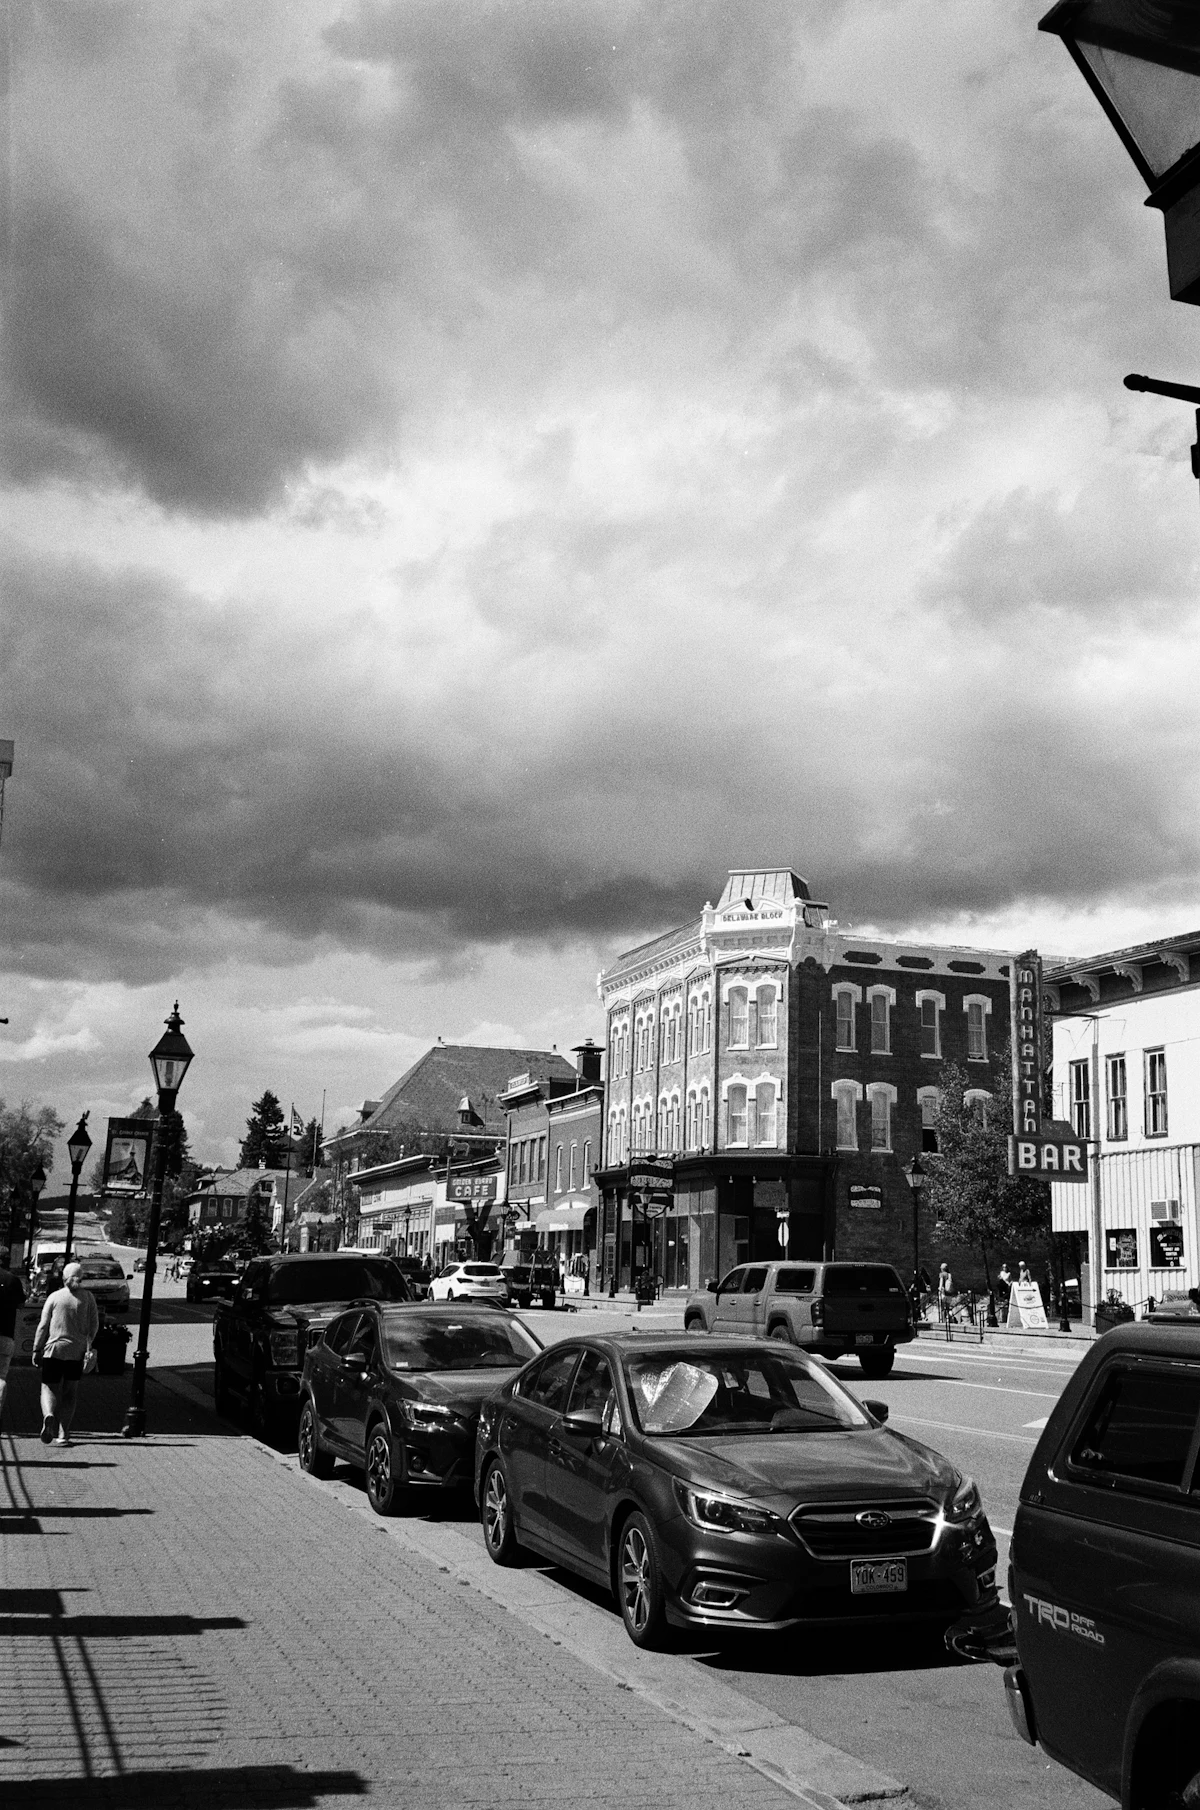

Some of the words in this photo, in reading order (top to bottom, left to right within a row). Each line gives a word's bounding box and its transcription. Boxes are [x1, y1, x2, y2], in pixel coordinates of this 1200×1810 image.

[723, 913, 759, 922] DELAWARE
[761, 911, 783, 920] BLOCK
[1017, 1142, 1084, 1171] BAR
[455, 1185, 489, 1197] CAFE
[1023, 1593, 1070, 1630] TRD
[1070, 1612, 1095, 1628] OFF
[1070, 1623, 1105, 1643] ROAD
